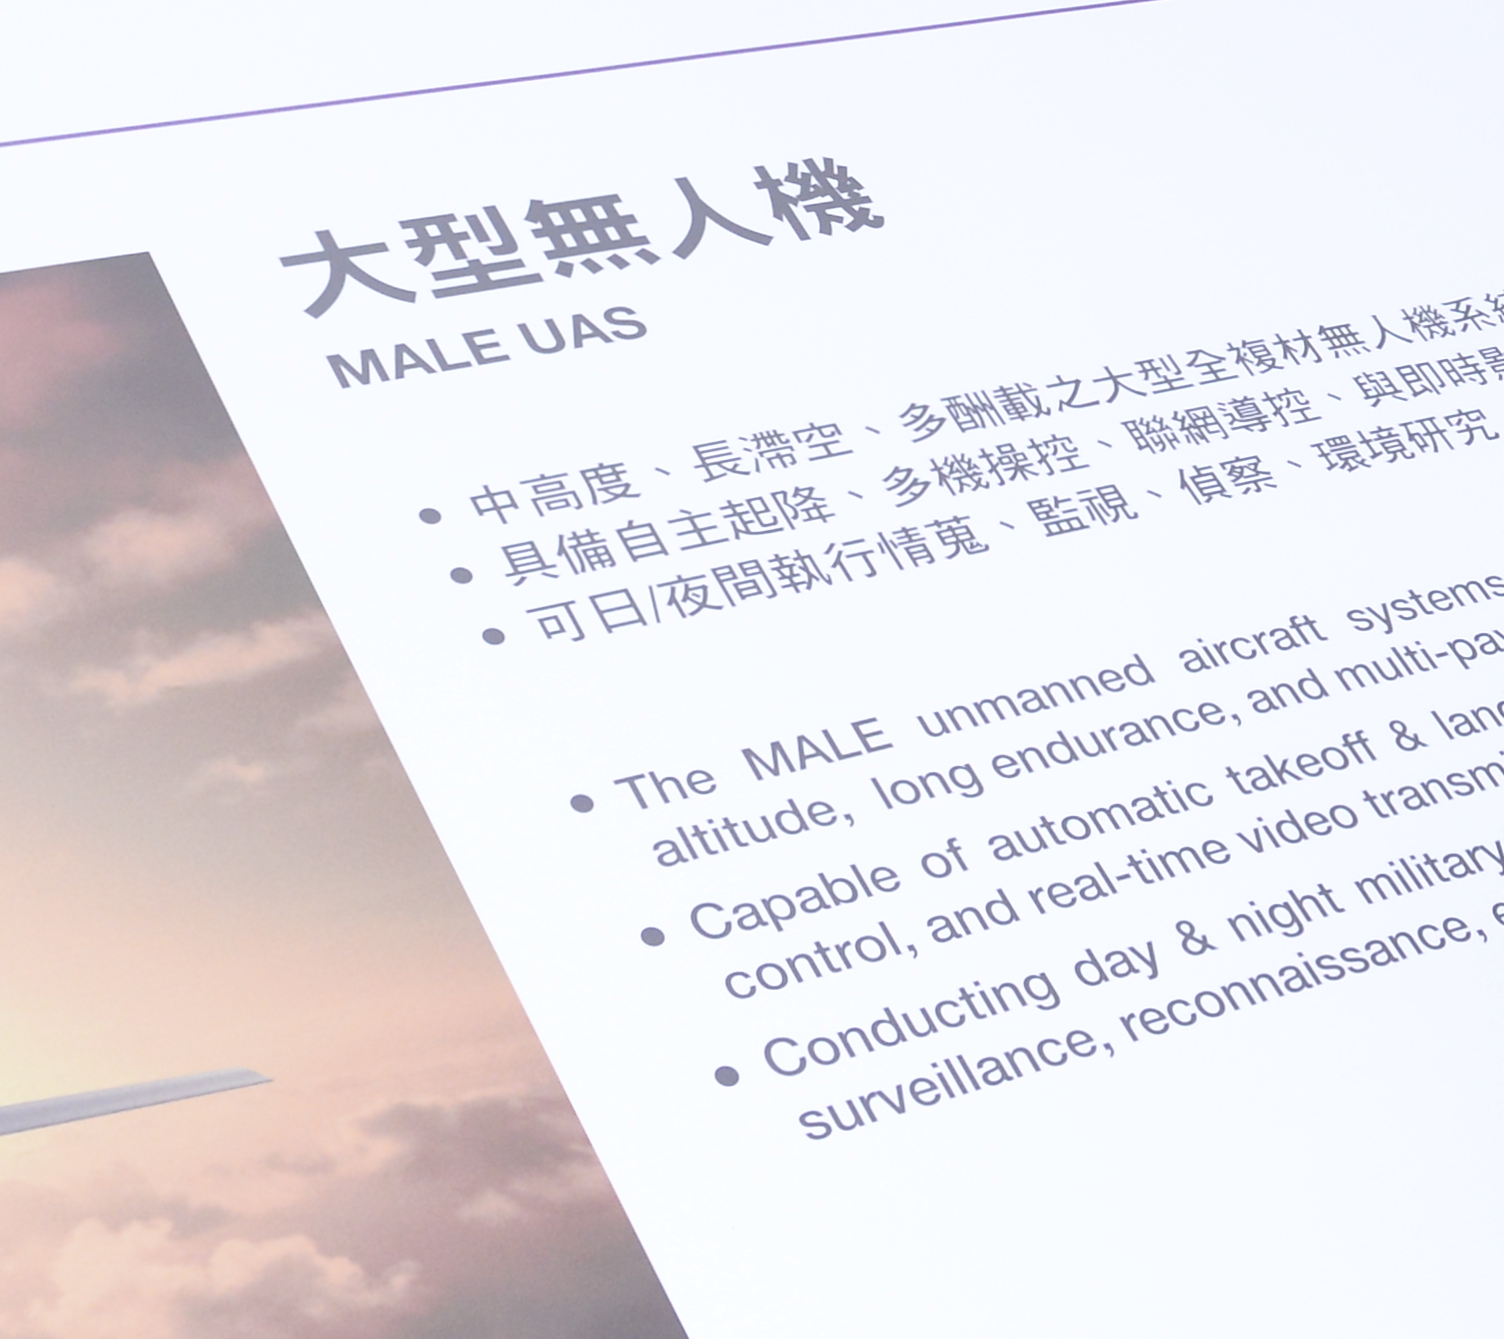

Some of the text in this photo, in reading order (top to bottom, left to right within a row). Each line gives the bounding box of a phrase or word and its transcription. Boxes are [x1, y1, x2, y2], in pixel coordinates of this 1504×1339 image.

[279, 156, 886, 320] 大型無人機
[326, 306, 649, 390] MALE UAS
[613, 769, 717, 810] The
[740, 717, 894, 781] MALE
[916, 653, 1156, 738] unmanned
[1178, 614, 1329, 674] aircraft
[652, 798, 855, 868] altitude,
[870, 763, 984, 810] long
[991, 700, 1242, 780] endurance,
[1246, 667, 1330, 715] and
[690, 864, 901, 940] Capable
[920, 837, 969, 879] of
[987, 779, 1214, 862] automatic
[1225, 729, 1378, 796] takeoff
[1388, 718, 1429, 753] &
[724, 920, 919, 1000] control,
[926, 888, 1021, 943] and
[1027, 837, 1232, 915] real-time
[1235, 804, 1359, 856] video
[763, 971, 1061, 1077] Conducting
[1073, 948, 1161, 987] day
[1174, 919, 1218, 956] &
[1226, 881, 1346, 943] night
[798, 1028, 1115, 1141] surveillance,
[1119, 916, 1489, 1043] reconnaissance,
